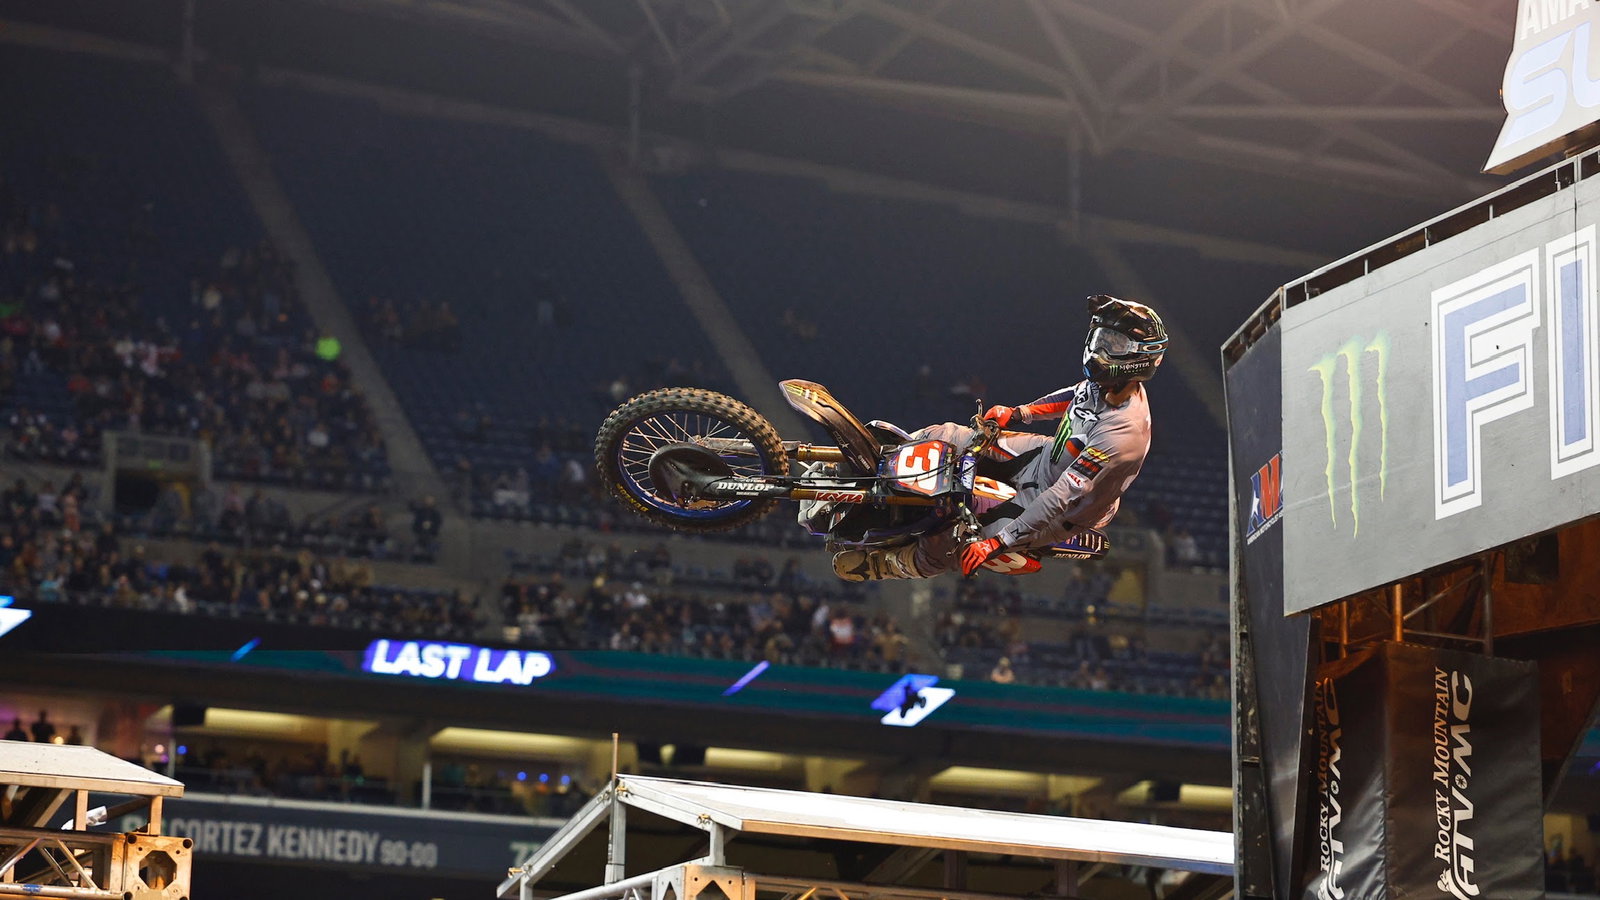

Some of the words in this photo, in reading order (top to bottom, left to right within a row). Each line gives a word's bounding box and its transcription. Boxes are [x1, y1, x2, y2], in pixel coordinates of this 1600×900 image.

[1120, 361, 1150, 371] MONSTER
[716, 482, 774, 491] DUNLOP
[1246, 451, 1283, 538] AM
[371, 639, 471, 679] LAST
[474, 648, 551, 685] LAP
[1316, 680, 1329, 797] MOUNTAIN
[1433, 666, 1451, 788] MOUNTAIN
[267, 824, 379, 864] KENNEDY
[1320, 801, 1330, 872] ROCKY
[1434, 789, 1450, 864] ROCKY
